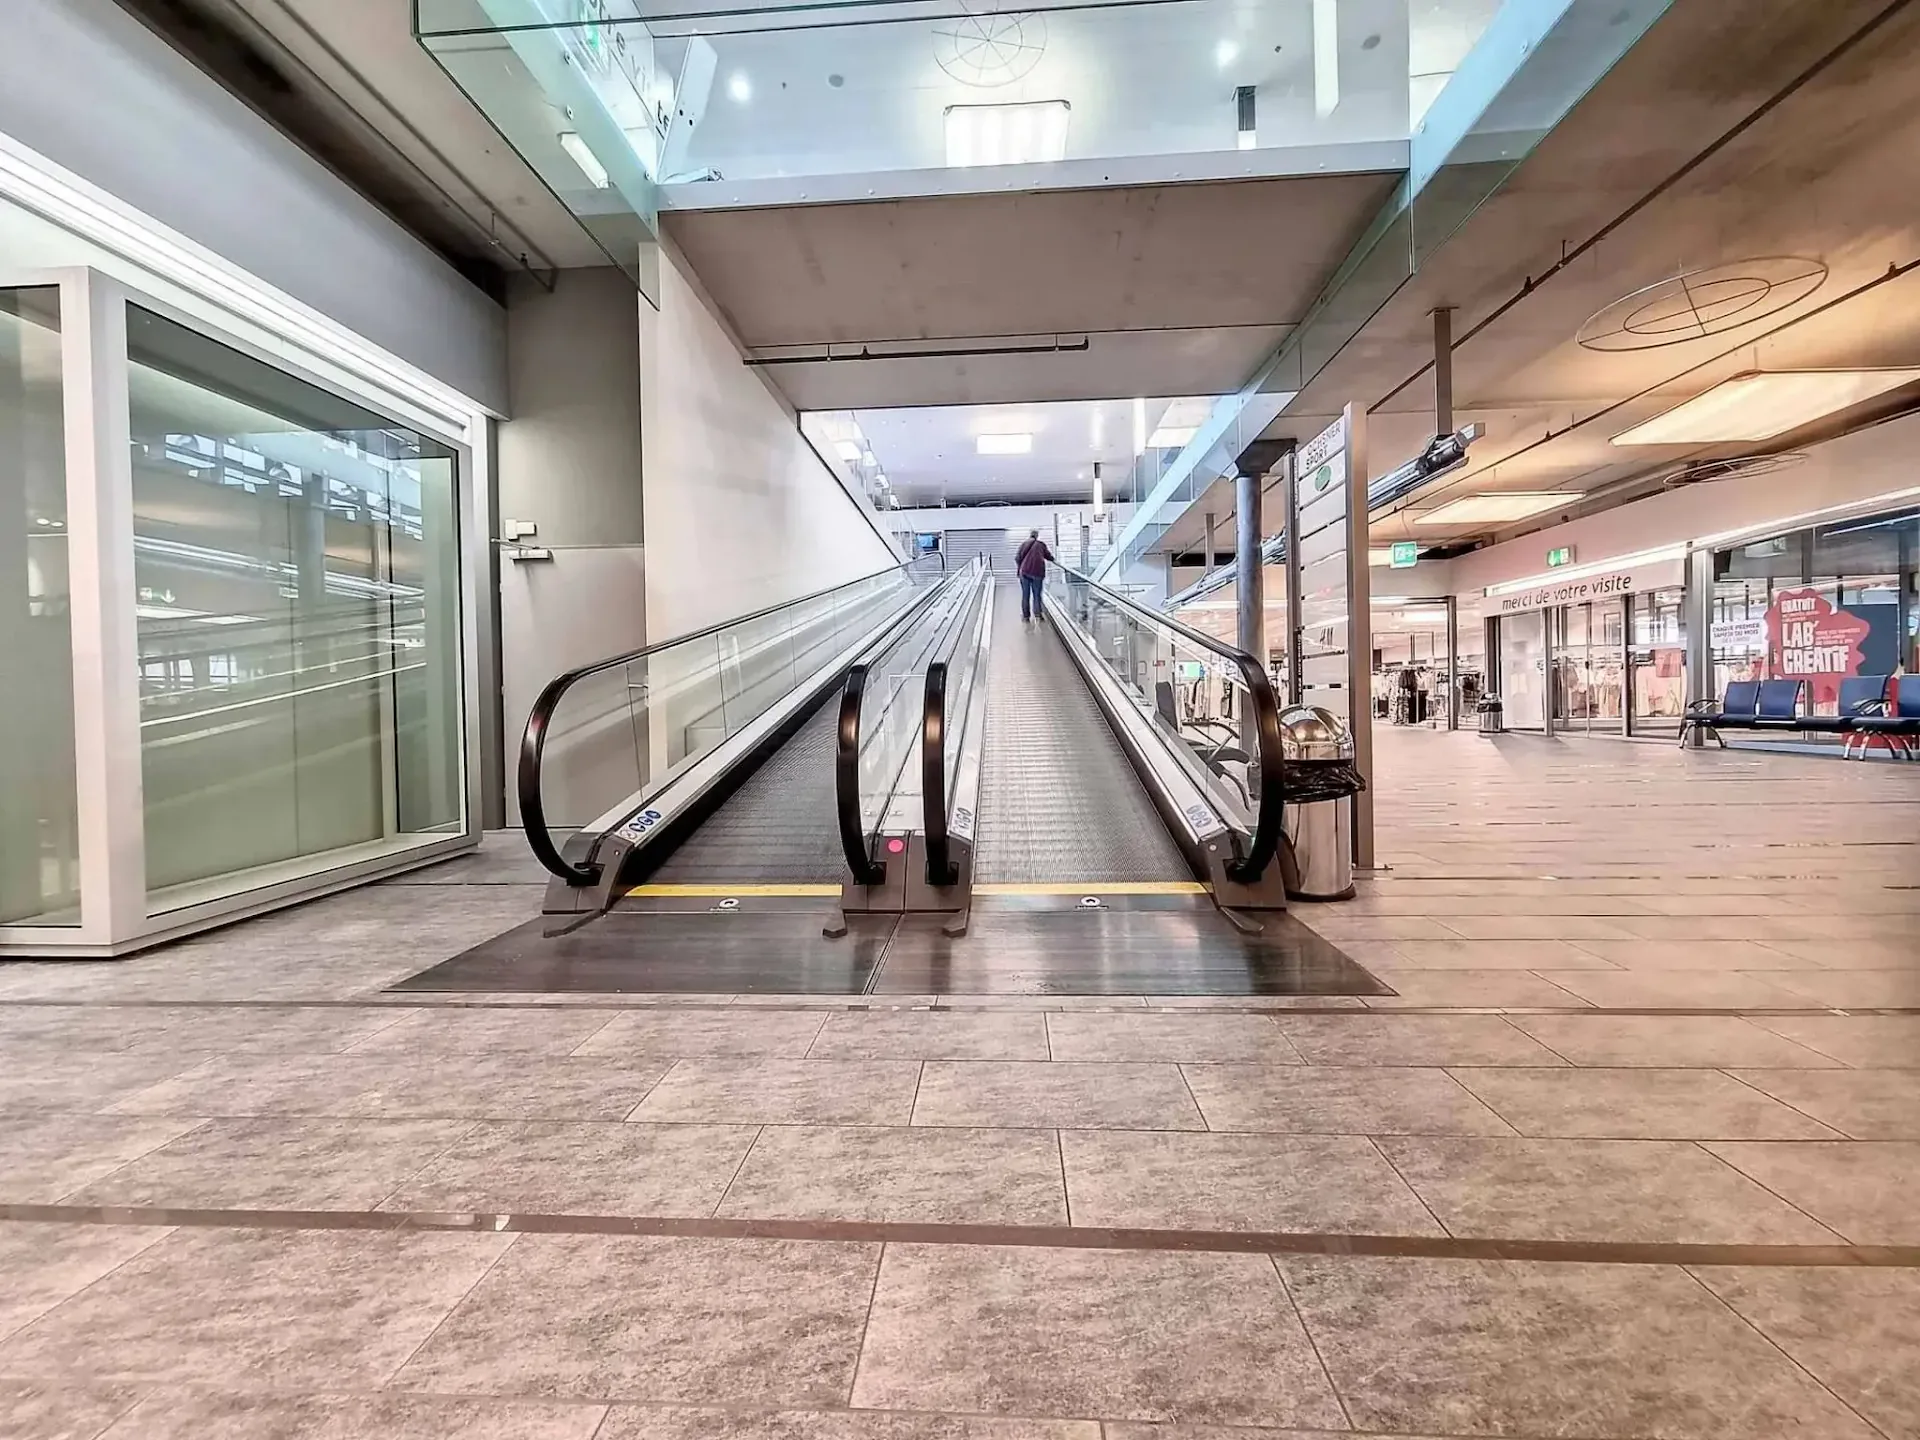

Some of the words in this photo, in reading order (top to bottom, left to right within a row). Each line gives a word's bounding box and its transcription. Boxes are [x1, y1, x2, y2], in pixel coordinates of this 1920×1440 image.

[1306, 443, 1328, 470] SPORT
[1502, 592, 1532, 611] merci
[1535, 589, 1550, 604] de
[1553, 584, 1588, 601] votre
[1591, 575, 1632, 594] visite
